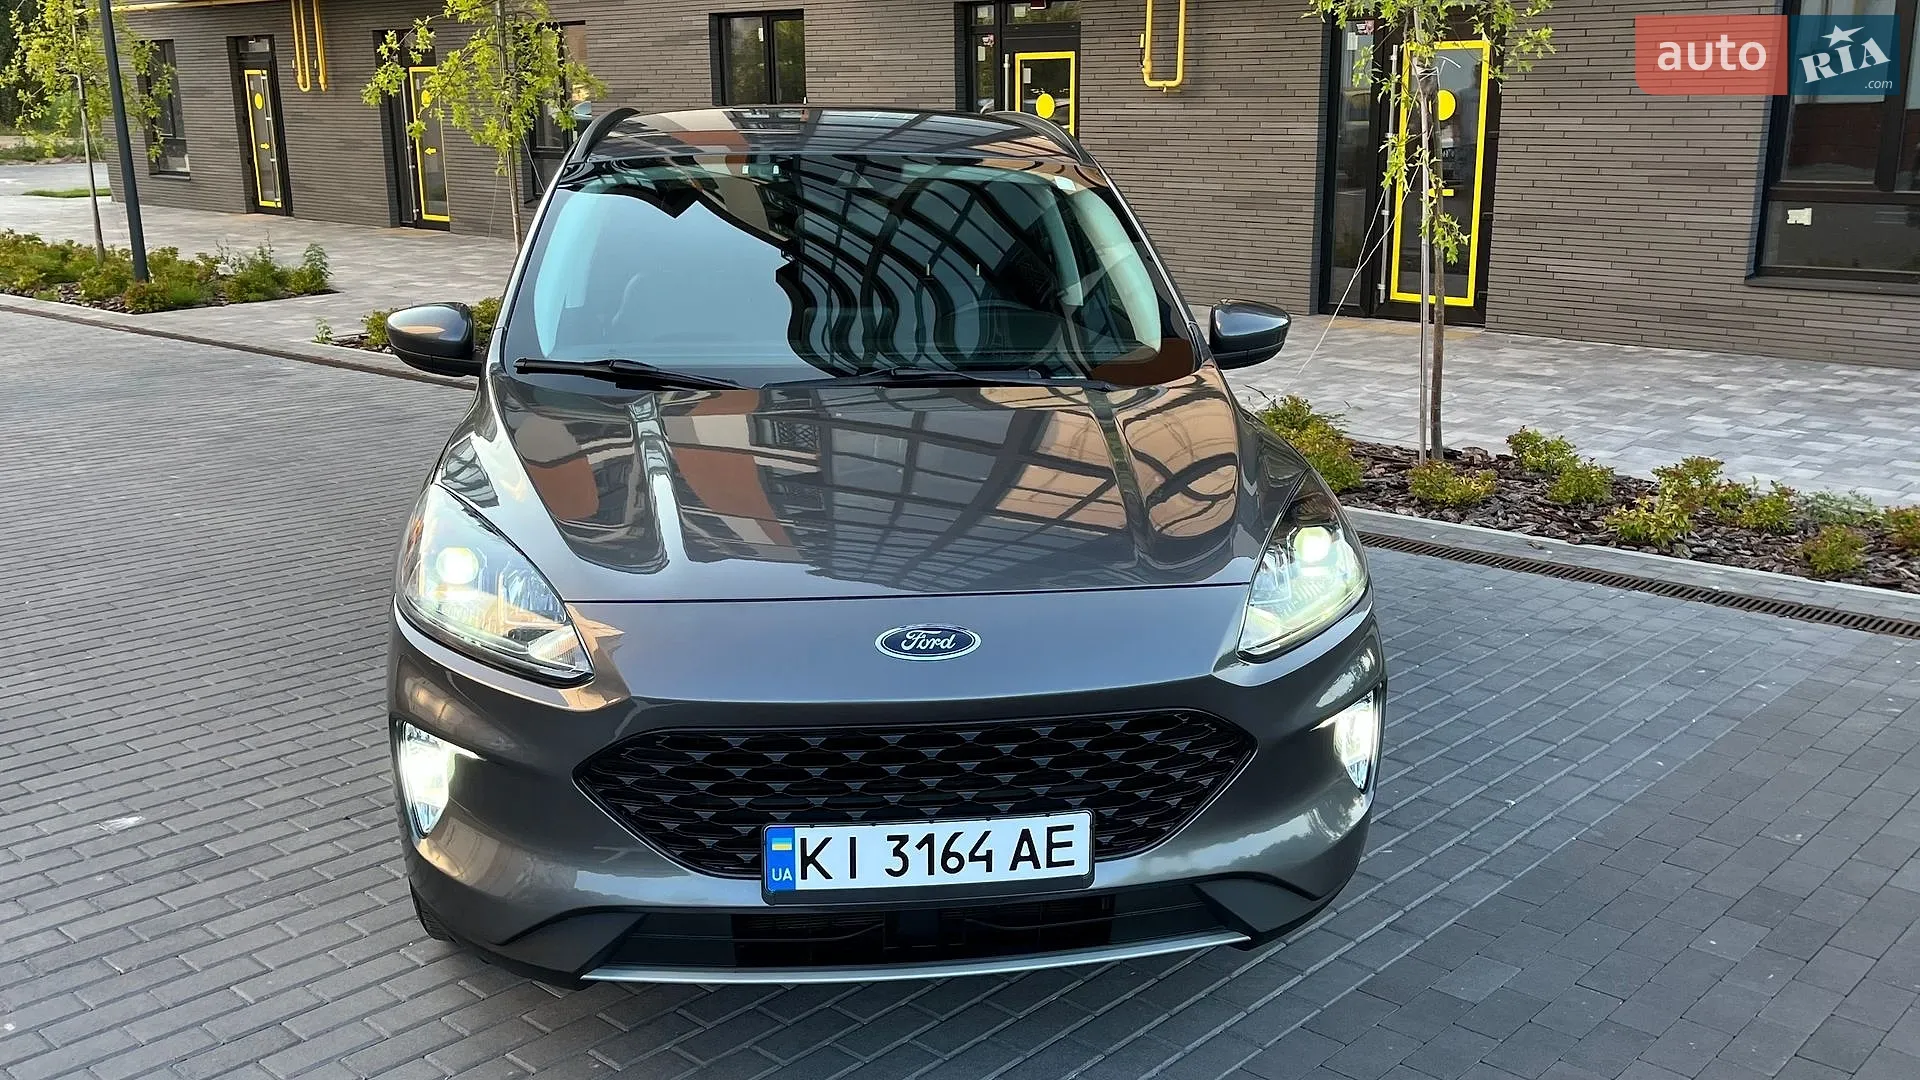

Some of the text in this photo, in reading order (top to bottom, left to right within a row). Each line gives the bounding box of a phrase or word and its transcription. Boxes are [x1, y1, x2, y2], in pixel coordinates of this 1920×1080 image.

[901, 629, 957, 651] Ford
[800, 824, 1076, 880] KI 3164 AE
[771, 867, 793, 882] UA
